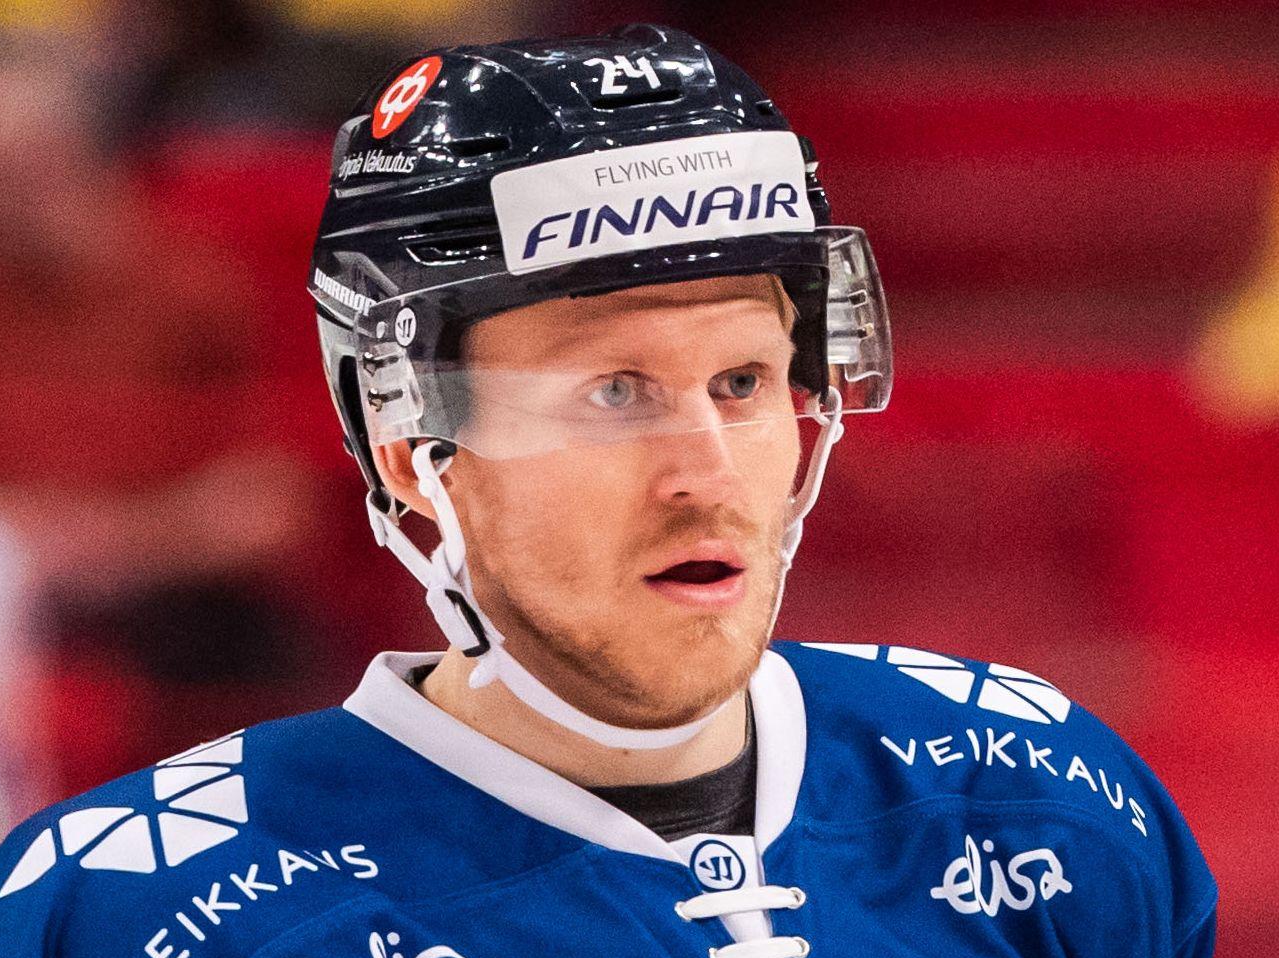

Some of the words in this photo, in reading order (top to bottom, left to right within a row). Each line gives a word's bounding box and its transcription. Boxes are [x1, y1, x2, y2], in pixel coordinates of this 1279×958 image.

[582, 55, 662, 95] 24
[594, 157, 675, 188] FLYING
[677, 150, 733, 177] WITH
[522, 182, 800, 261] FINNAIR
[879, 727, 1148, 837] VEIKKAUS
[929, 834, 1073, 918] elisa
